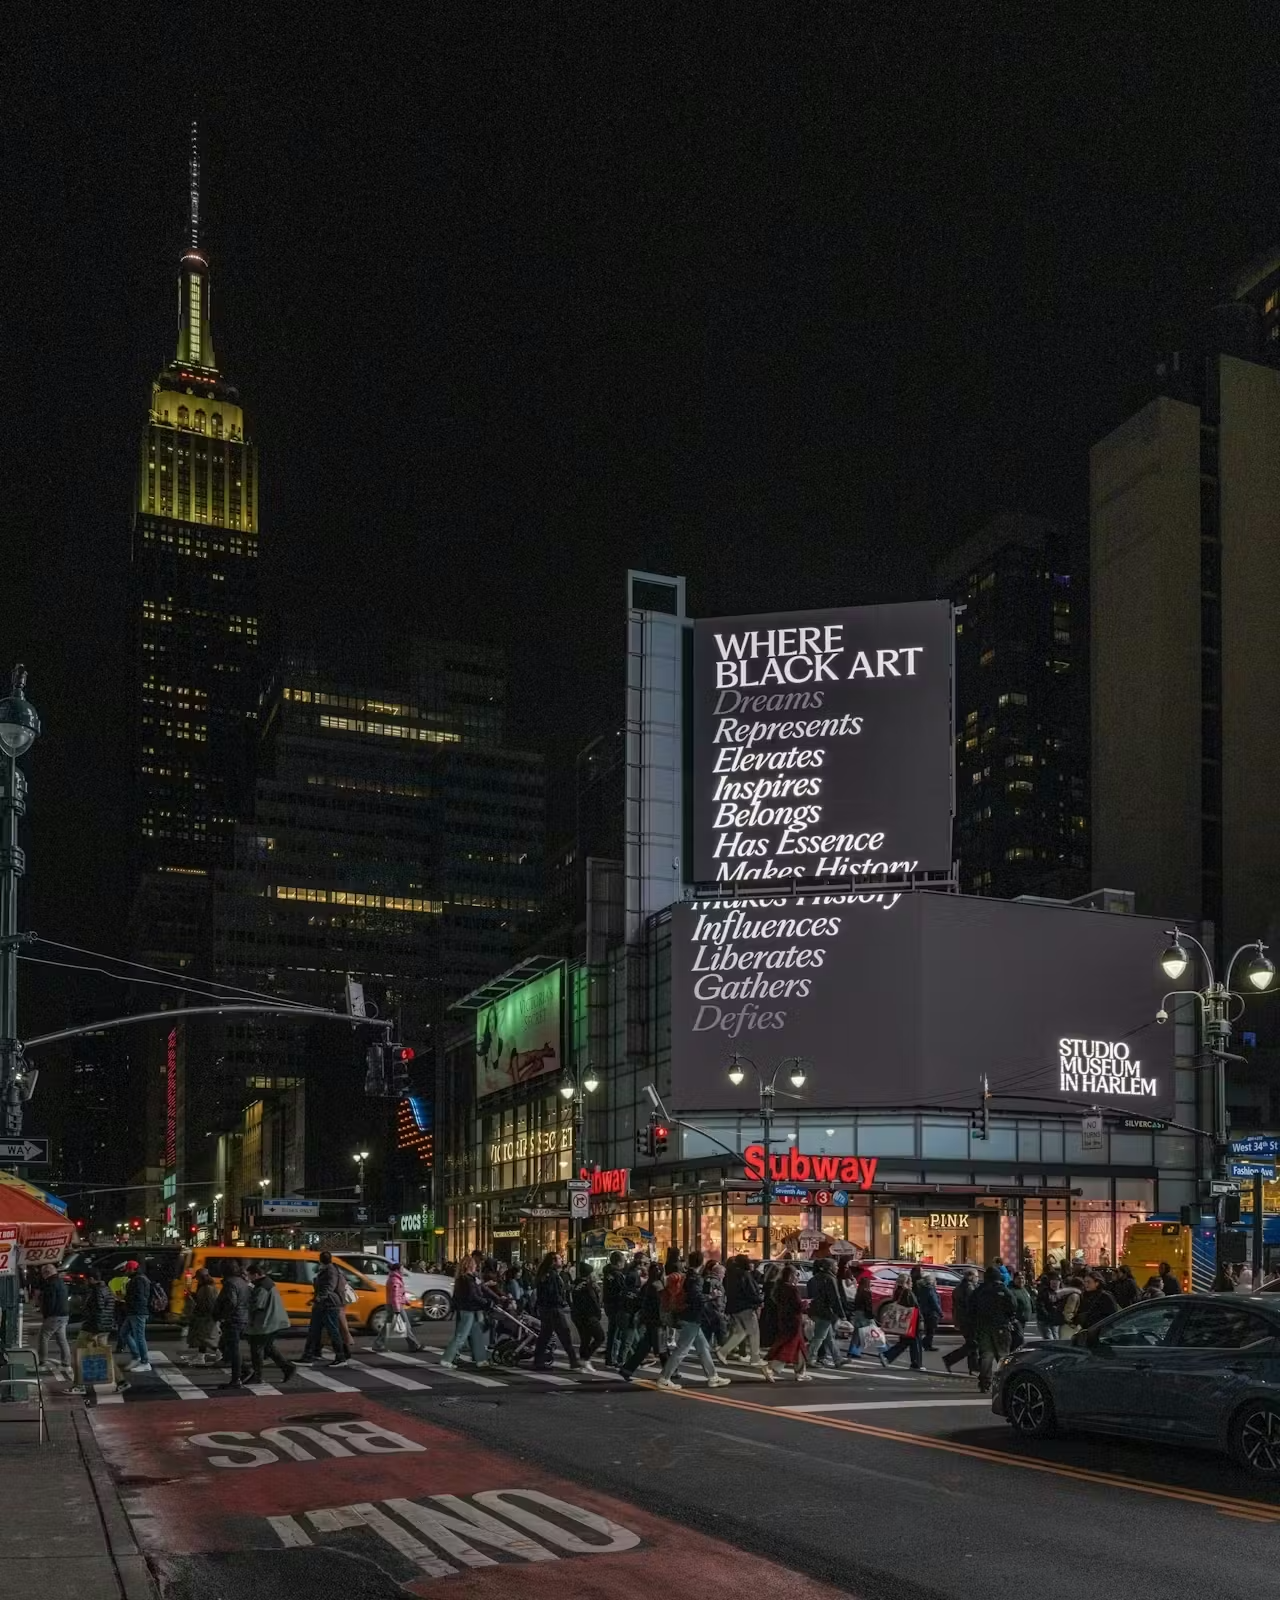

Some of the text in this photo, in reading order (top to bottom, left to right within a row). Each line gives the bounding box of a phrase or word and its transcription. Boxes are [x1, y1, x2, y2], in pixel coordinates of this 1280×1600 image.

[714, 624, 844, 660] WHERE
[716, 647, 923, 688] BLACK ART
[712, 689, 824, 716] Dreams
[712, 713, 864, 748] Represents
[712, 746, 825, 773] Elevates
[712, 773, 822, 806] Inspires
[712, 801, 822, 831] Belongs
[712, 829, 884, 858] Has Essence
[691, 910, 842, 945] Influences
[691, 944, 826, 972] Liberates
[694, 972, 812, 1000] Gathers
[692, 1003, 787, 1038] Defies
[1058, 1038, 1130, 1060] STUDIO
[1060, 1056, 1140, 1078] MUSEUM
[1060, 1074, 1156, 1096] IN HARLEM
[1086, 1120, 1096, 1128] NO
[8, 1146, 32, 1154] WAY
[538, 1127, 572, 1153] SECET
[1232, 1140, 1278, 1152] West 34th St
[744, 1145, 878, 1190] Subway
[1233, 1166, 1258, 1176] Fashion
[819, 1192, 828, 1204] 3
[930, 1214, 969, 1228] PINK
[1080, 1216, 1111, 1232] PIN
[188, 1420, 428, 1468] BUS
